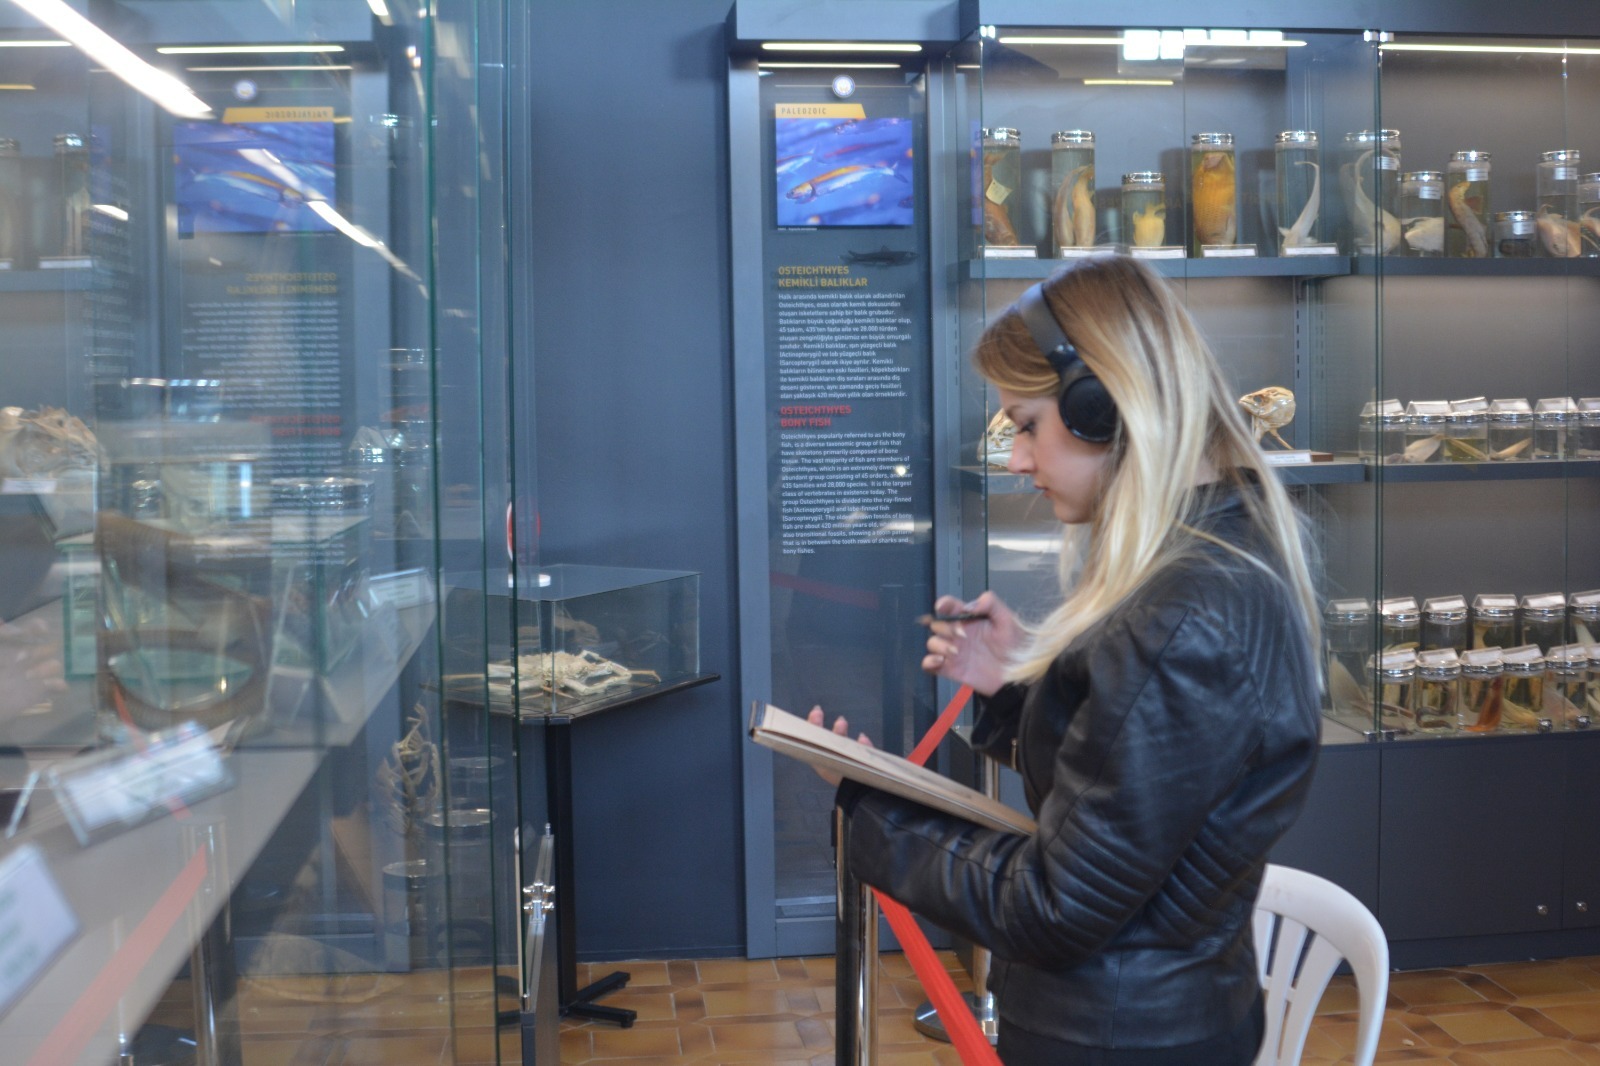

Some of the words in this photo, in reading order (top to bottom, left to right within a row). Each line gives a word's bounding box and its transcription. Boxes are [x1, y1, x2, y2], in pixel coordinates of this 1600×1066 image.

[781, 107, 827, 115] PALEOZOIC
[778, 265, 849, 275] OSTEICHTHYES
[778, 276, 819, 287] KEMİKLİ
[820, 278, 868, 287] BALIKLAR
[781, 405, 852, 415] OSTEICHTHYES
[781, 418, 807, 427] BONY
[809, 418, 832, 427] FISH
